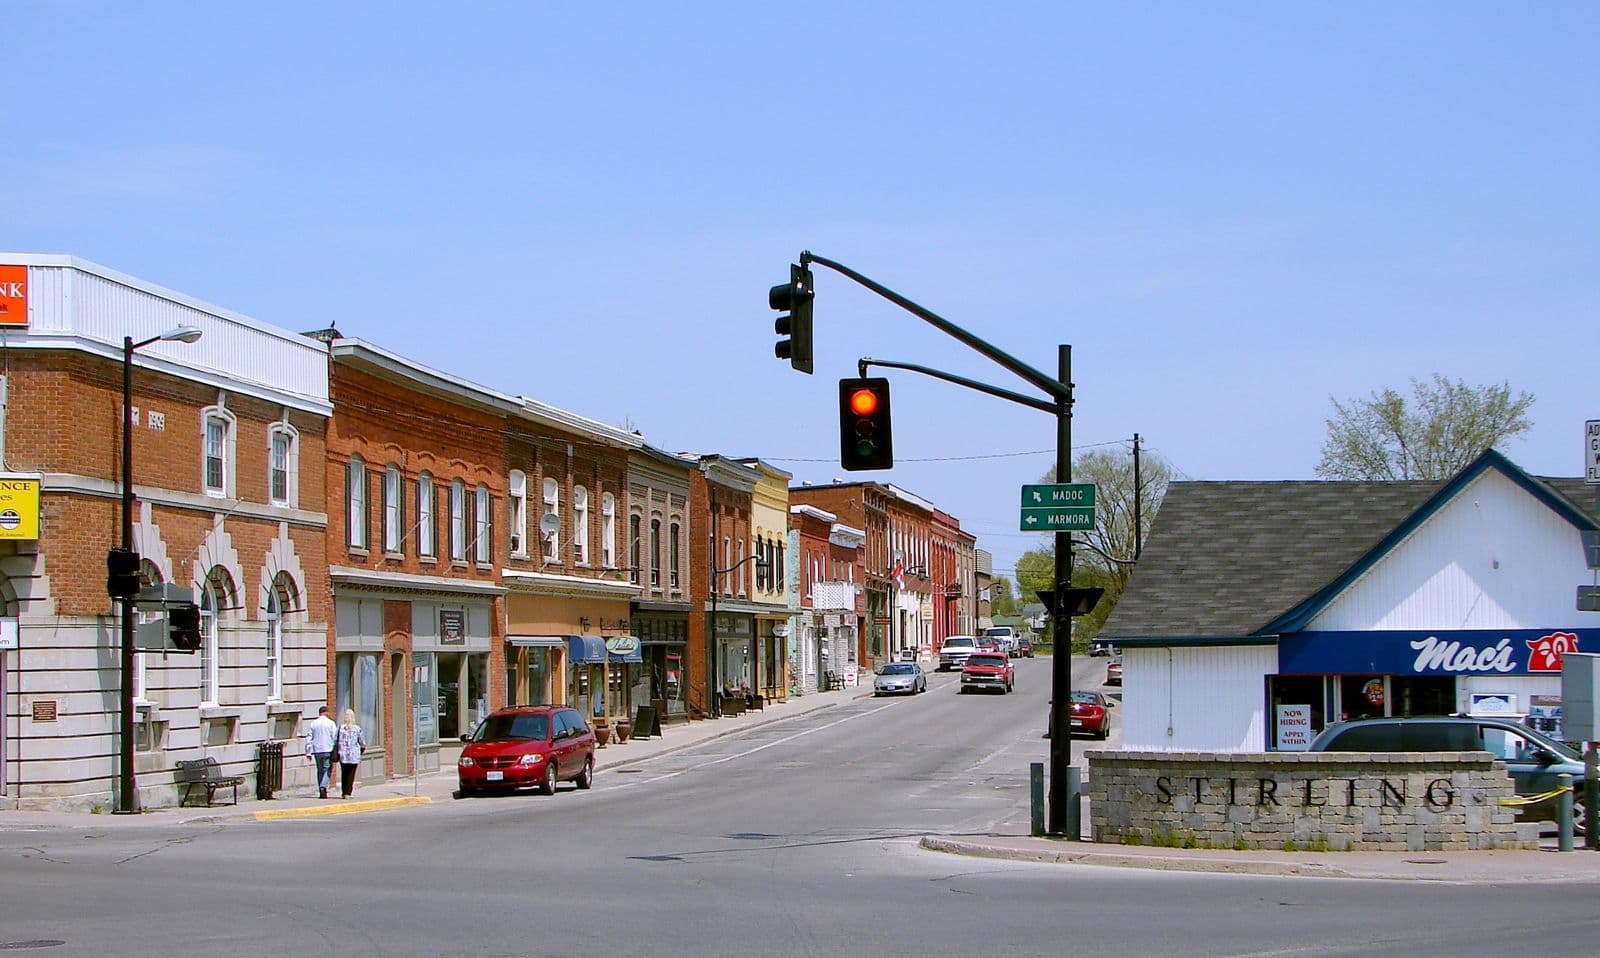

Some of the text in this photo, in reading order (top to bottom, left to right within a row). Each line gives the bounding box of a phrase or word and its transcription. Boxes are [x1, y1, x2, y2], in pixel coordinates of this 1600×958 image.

[1, 482, 31, 491] NCE
[1052, 490, 1083, 501] MADOC
[1047, 514, 1090, 524] MARMORA
[1410, 636, 1518, 673] Mac's
[1156, 776, 1455, 808] STIRLING
